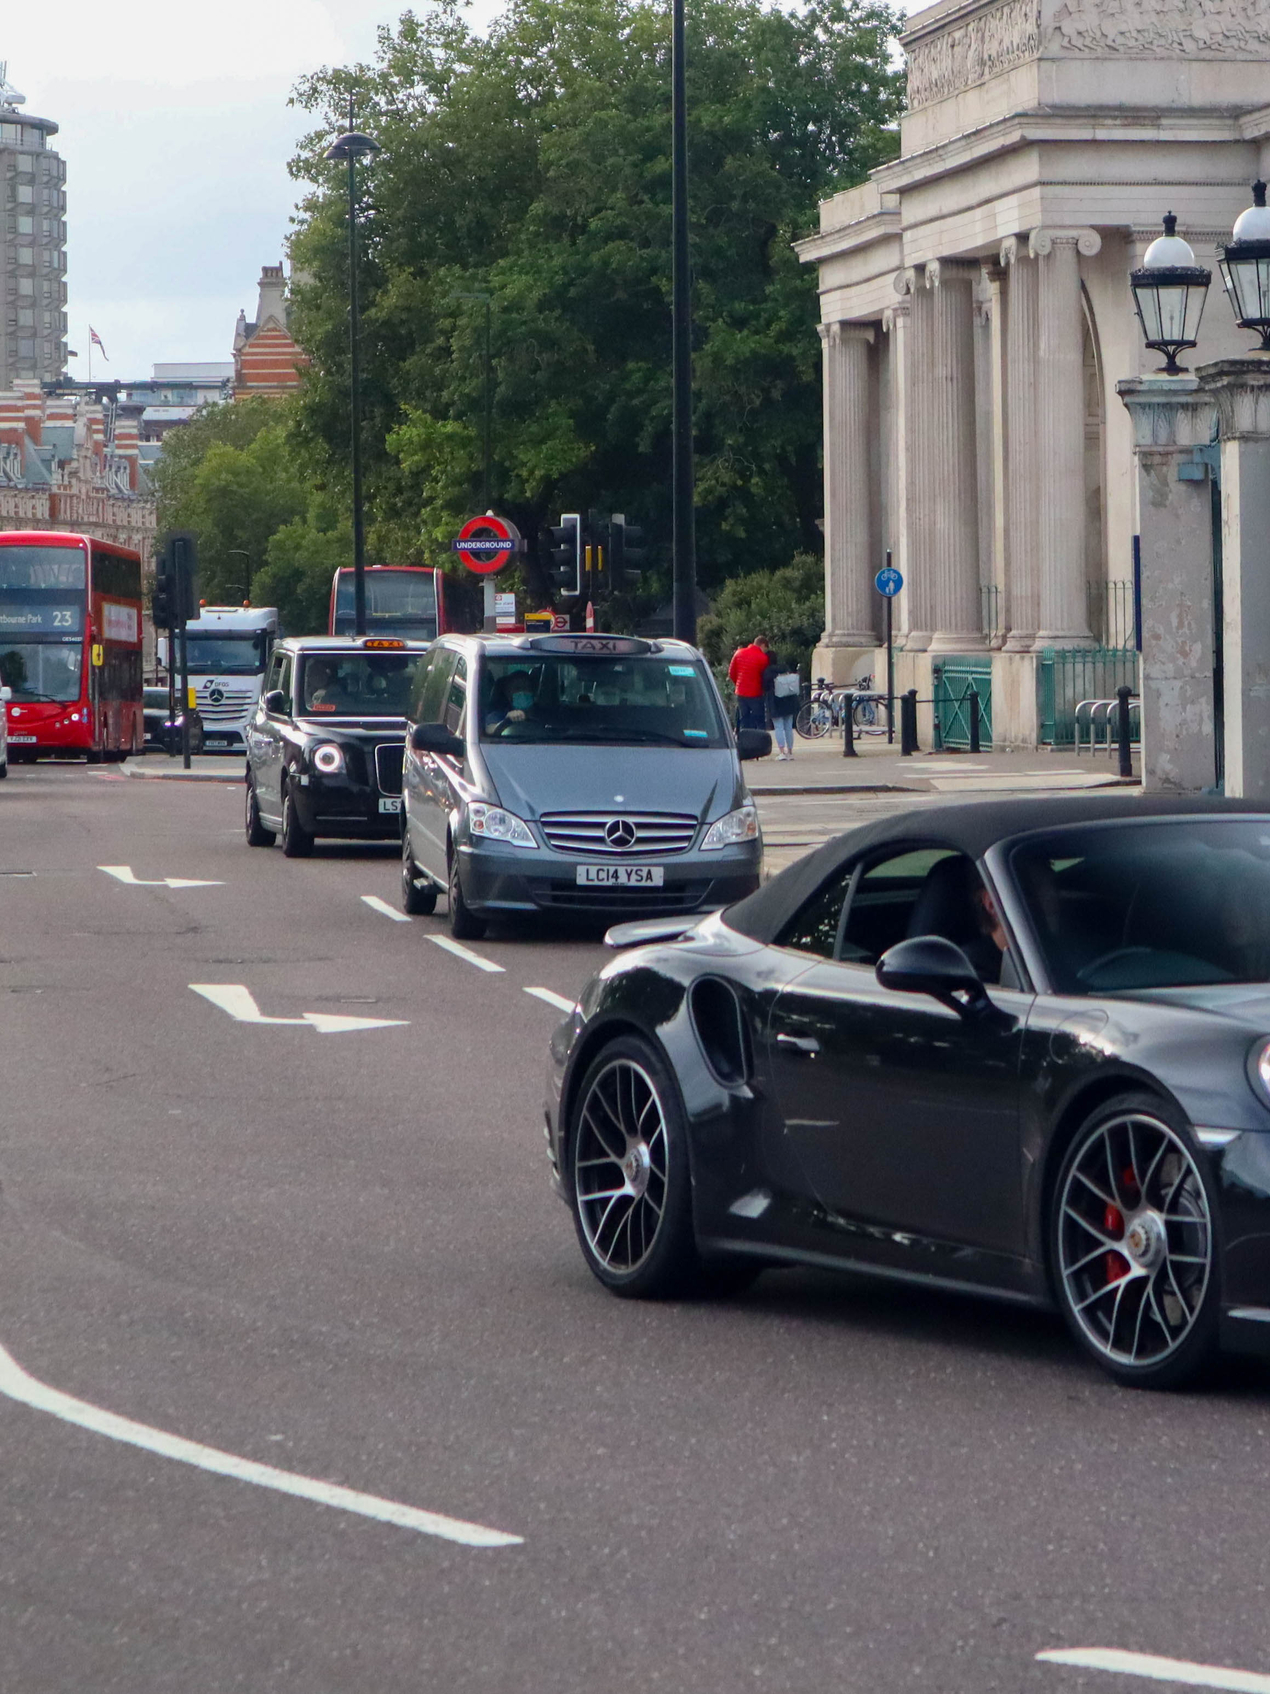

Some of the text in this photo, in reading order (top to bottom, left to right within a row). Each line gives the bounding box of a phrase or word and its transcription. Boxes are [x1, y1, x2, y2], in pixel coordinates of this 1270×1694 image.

[456, 541, 512, 549] UNDERGROUND
[27, 613, 42, 624] Park
[53, 611, 72, 626] 23
[570, 640, 617, 652] TAXI
[585, 867, 654, 883] LC14 YSA
